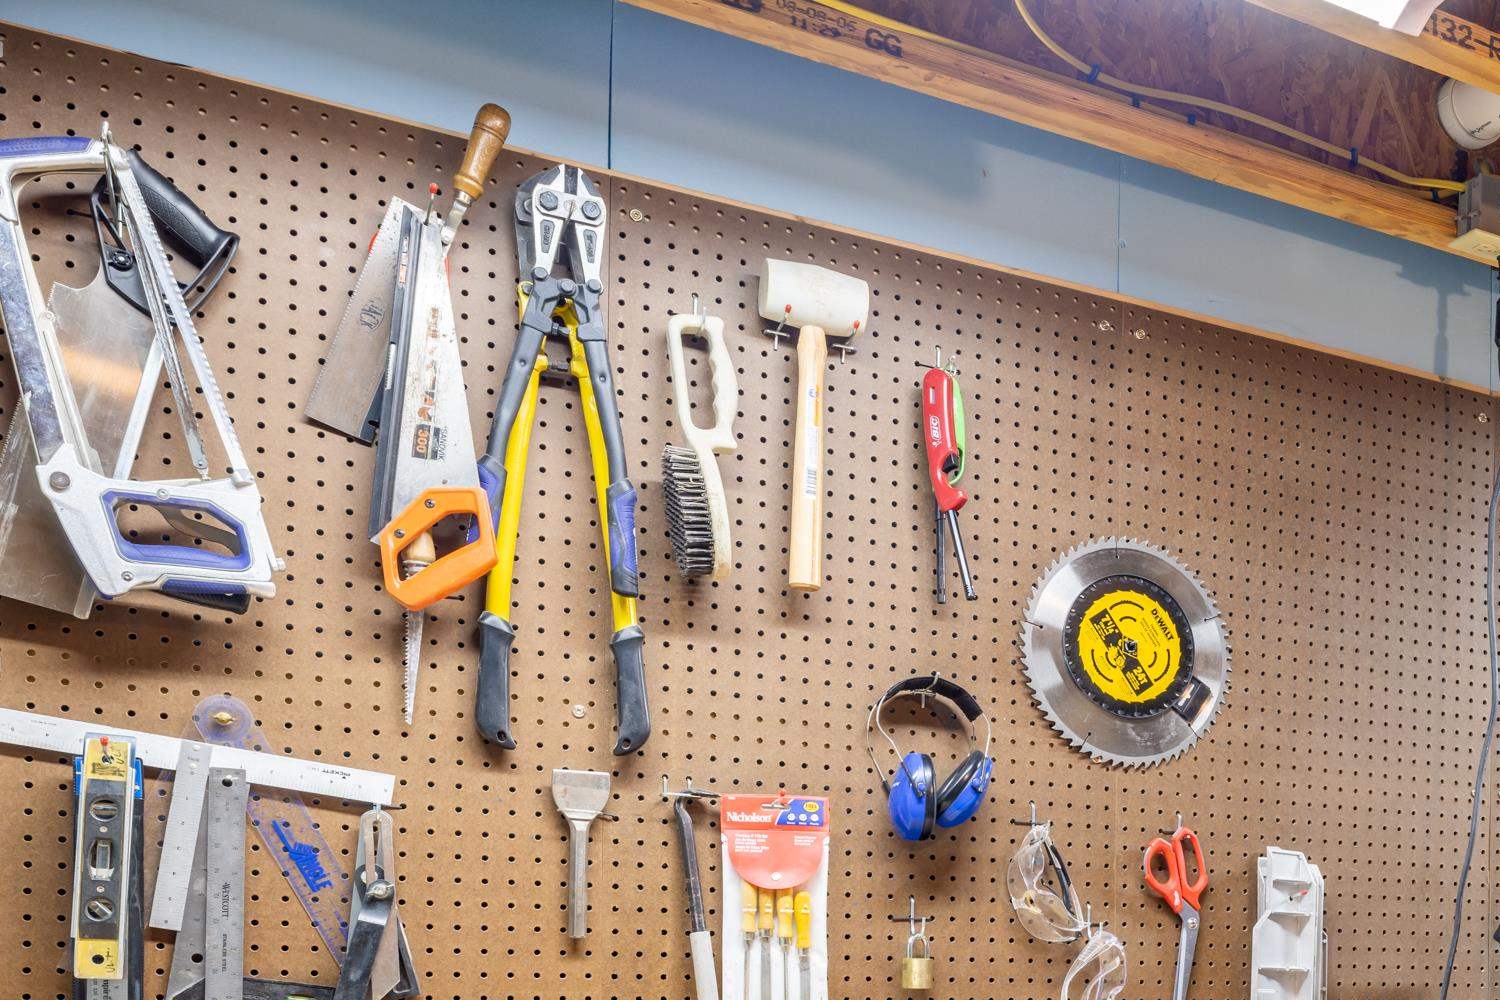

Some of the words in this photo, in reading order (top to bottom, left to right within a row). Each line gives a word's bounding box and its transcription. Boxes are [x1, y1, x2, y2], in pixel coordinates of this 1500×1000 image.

[864, 27, 903, 58] GG
[726, 811, 773, 823] Nicholson
[221, 882, 231, 919] WESTCOTT
